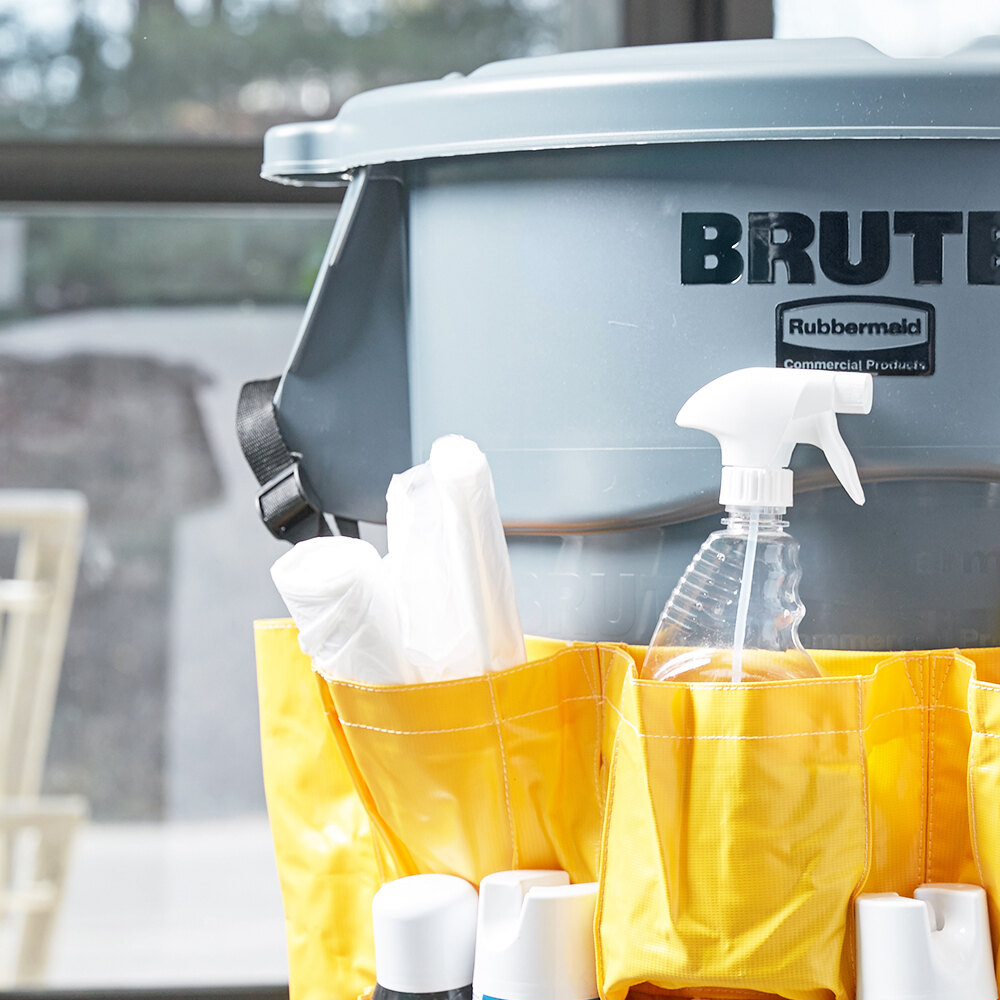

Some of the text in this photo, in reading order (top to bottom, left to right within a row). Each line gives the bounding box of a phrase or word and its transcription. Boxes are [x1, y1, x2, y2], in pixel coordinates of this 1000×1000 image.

[788, 318, 922, 335] Rubbermaid
[783, 358, 926, 371] Commercial Products
